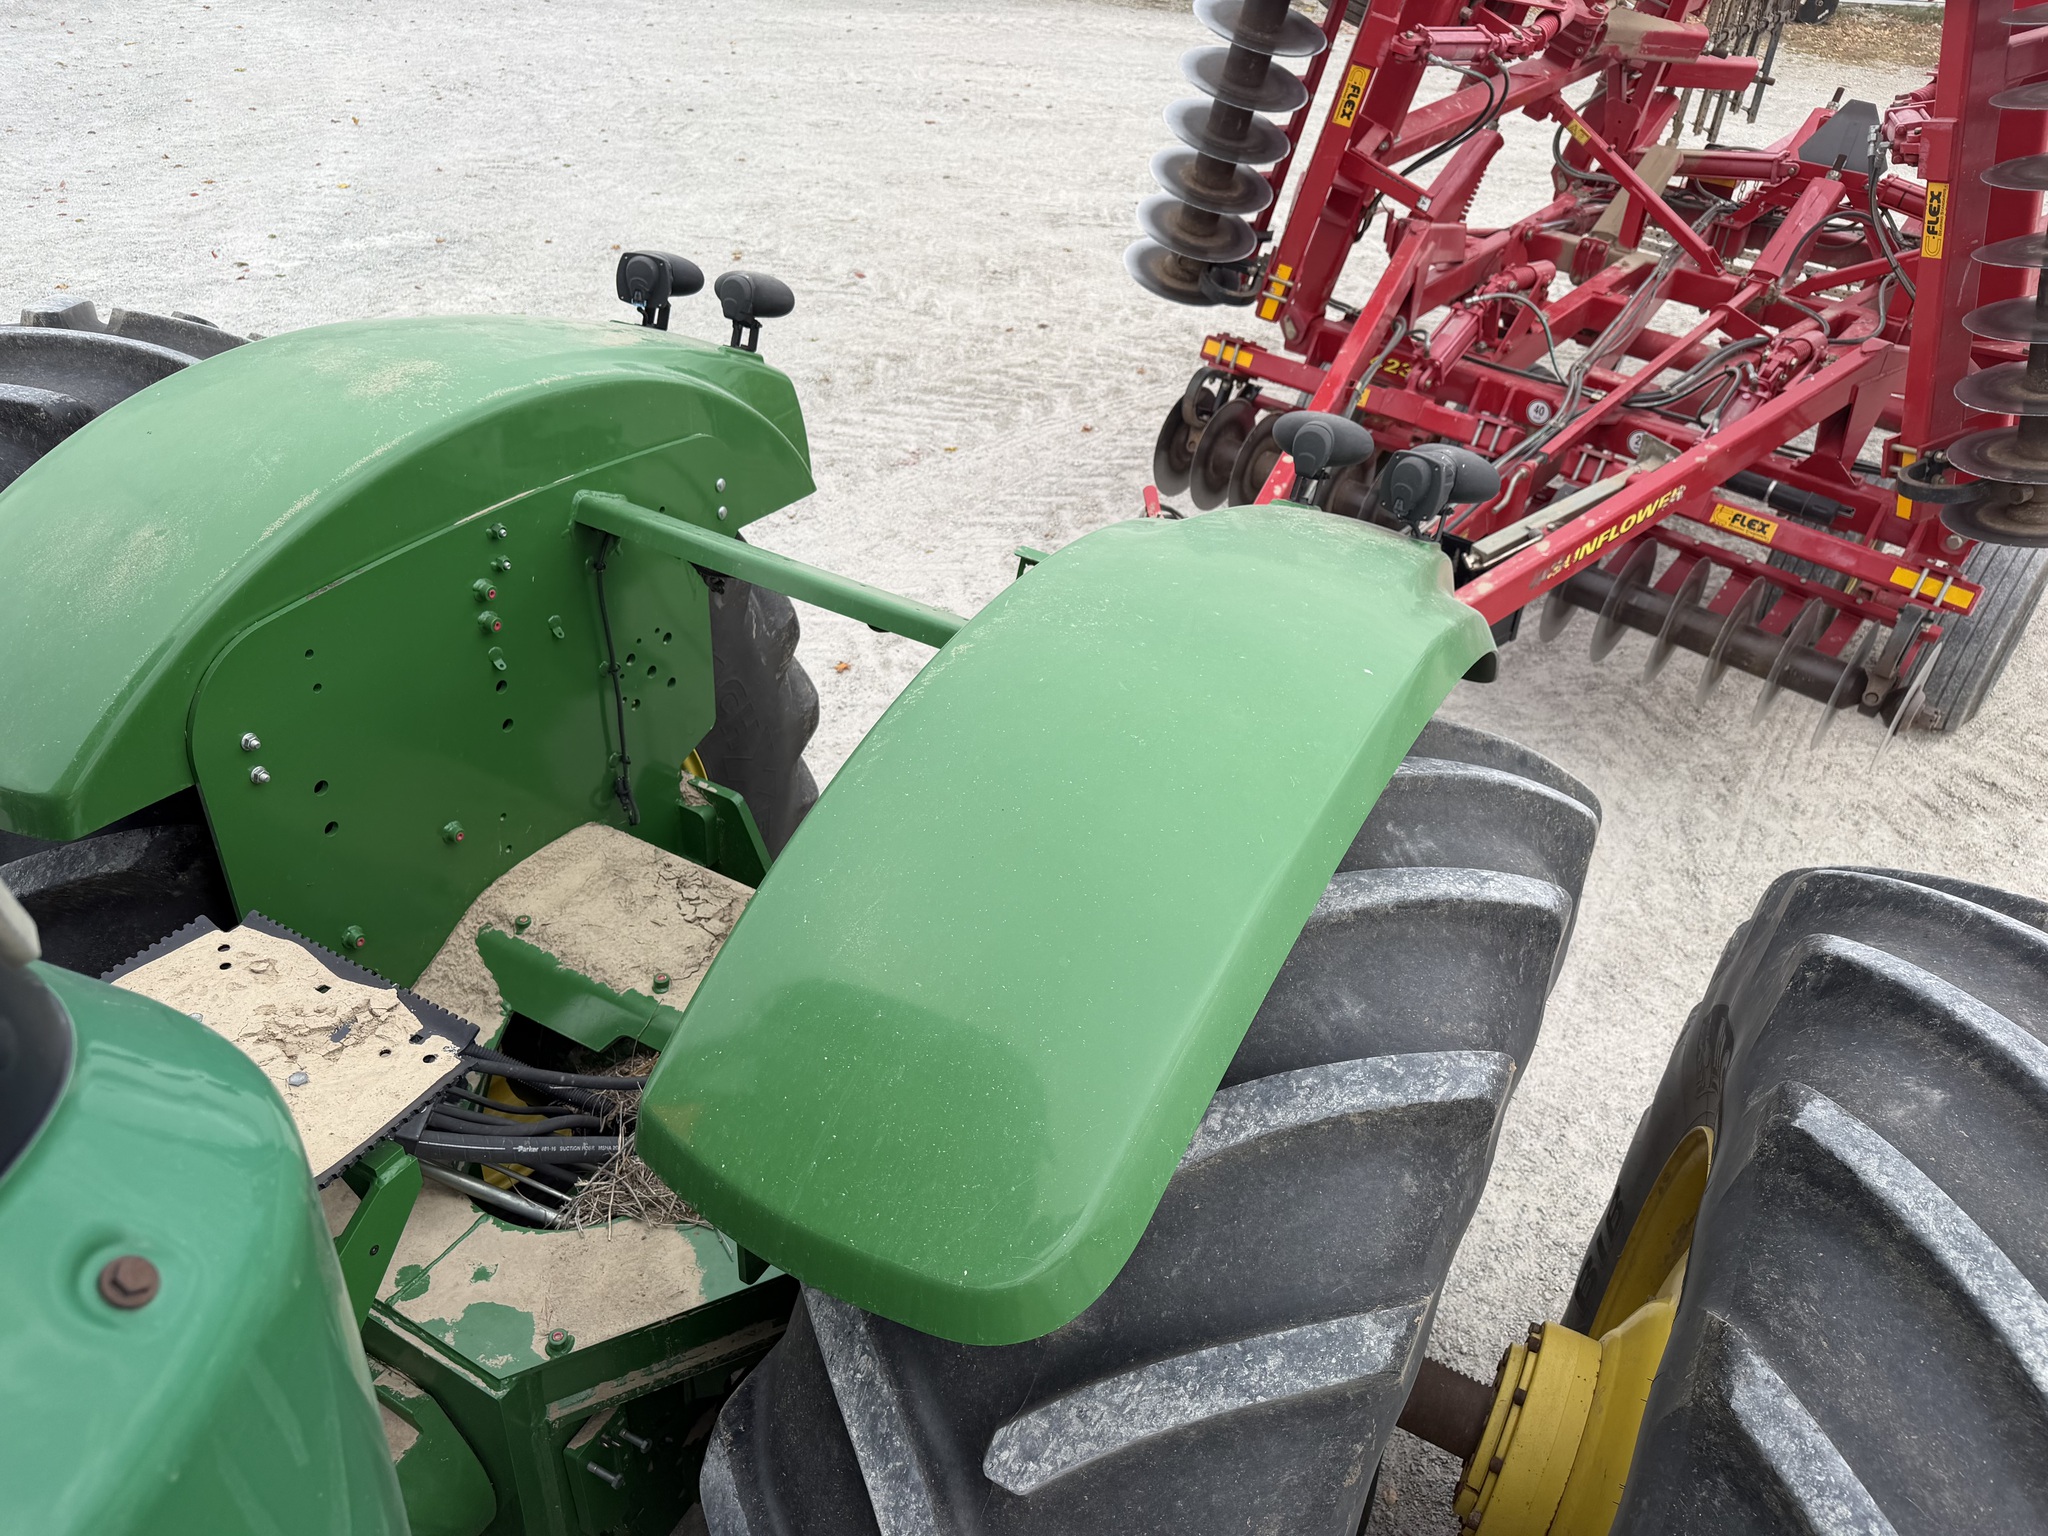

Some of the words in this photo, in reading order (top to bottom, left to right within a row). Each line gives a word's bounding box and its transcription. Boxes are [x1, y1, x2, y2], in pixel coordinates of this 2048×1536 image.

[1369, 355, 1412, 378] 23
[1533, 404, 1545, 416] 40
[517, 1145, 539, 1153] Parker
